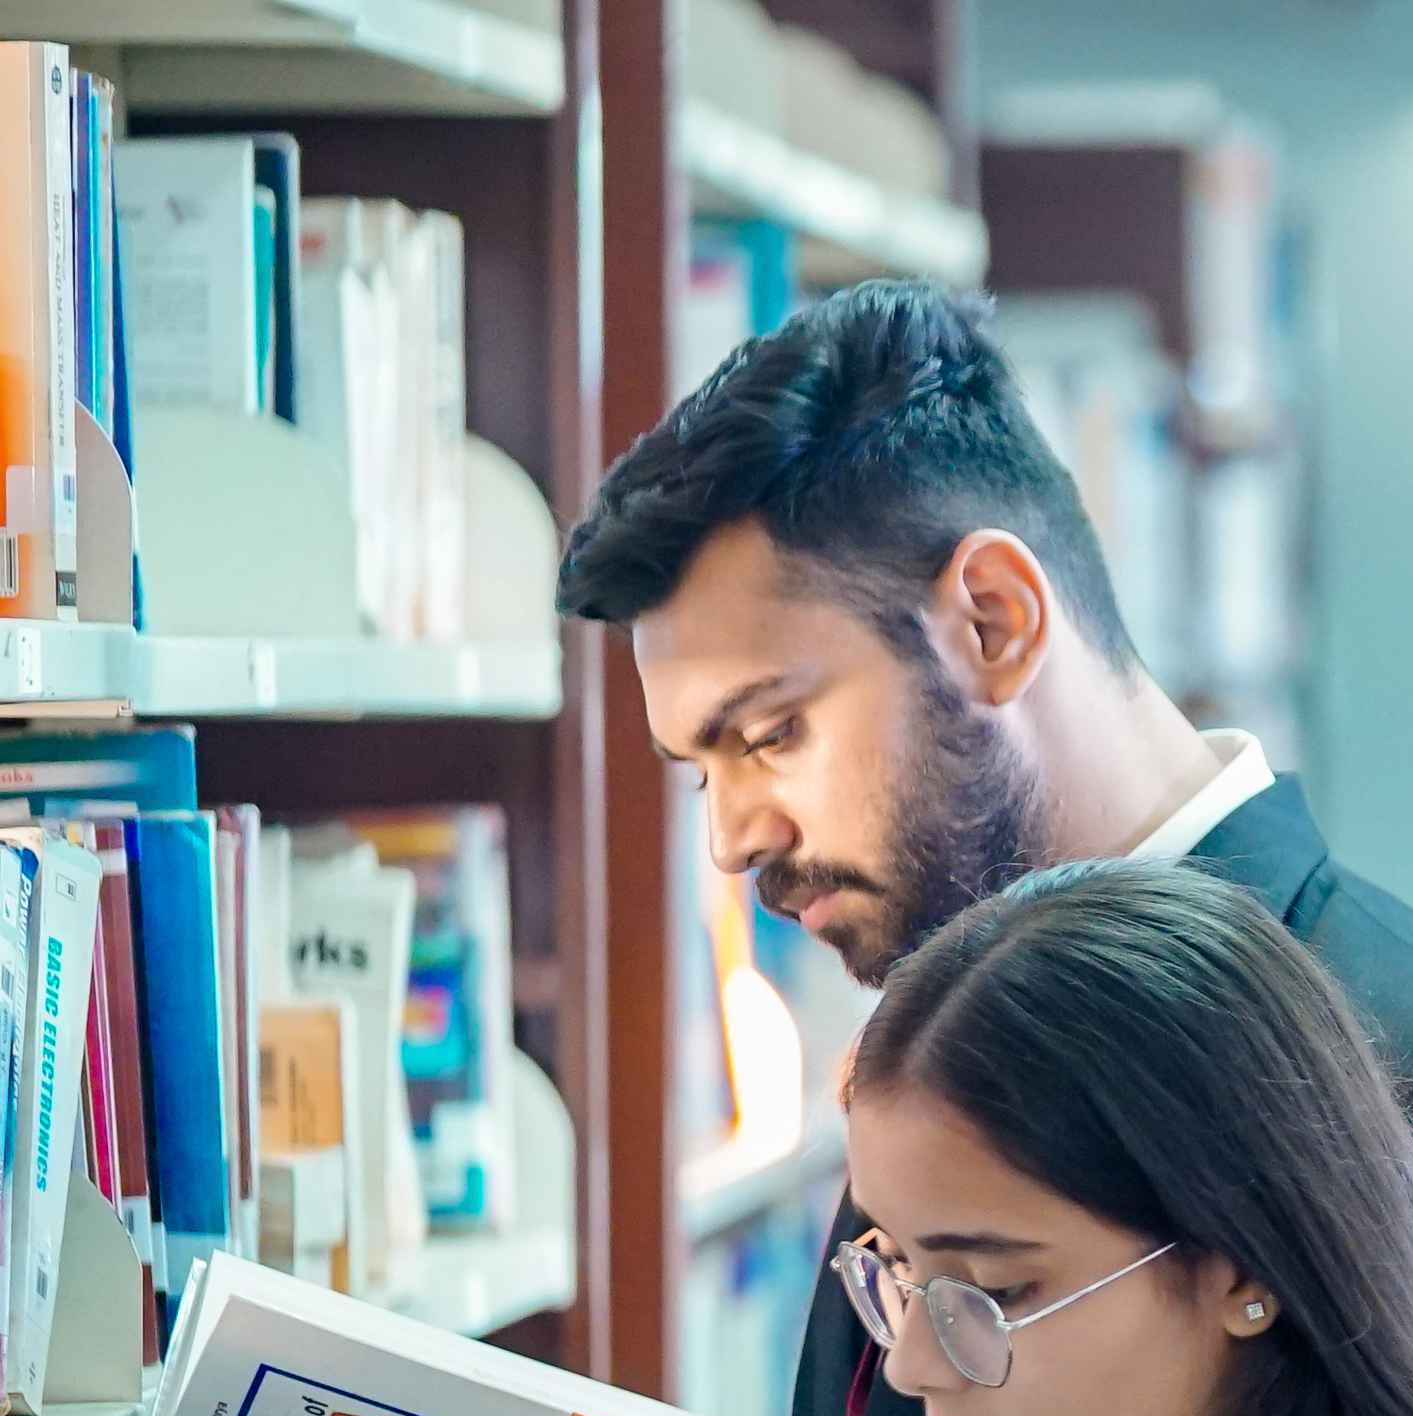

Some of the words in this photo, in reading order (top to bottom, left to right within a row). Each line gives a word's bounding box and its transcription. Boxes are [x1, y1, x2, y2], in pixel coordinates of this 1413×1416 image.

[44, 935, 63, 1013] BASIC
[35, 1020, 58, 1193] ELECTRONICS
[302, 1396, 329, 1416] of
